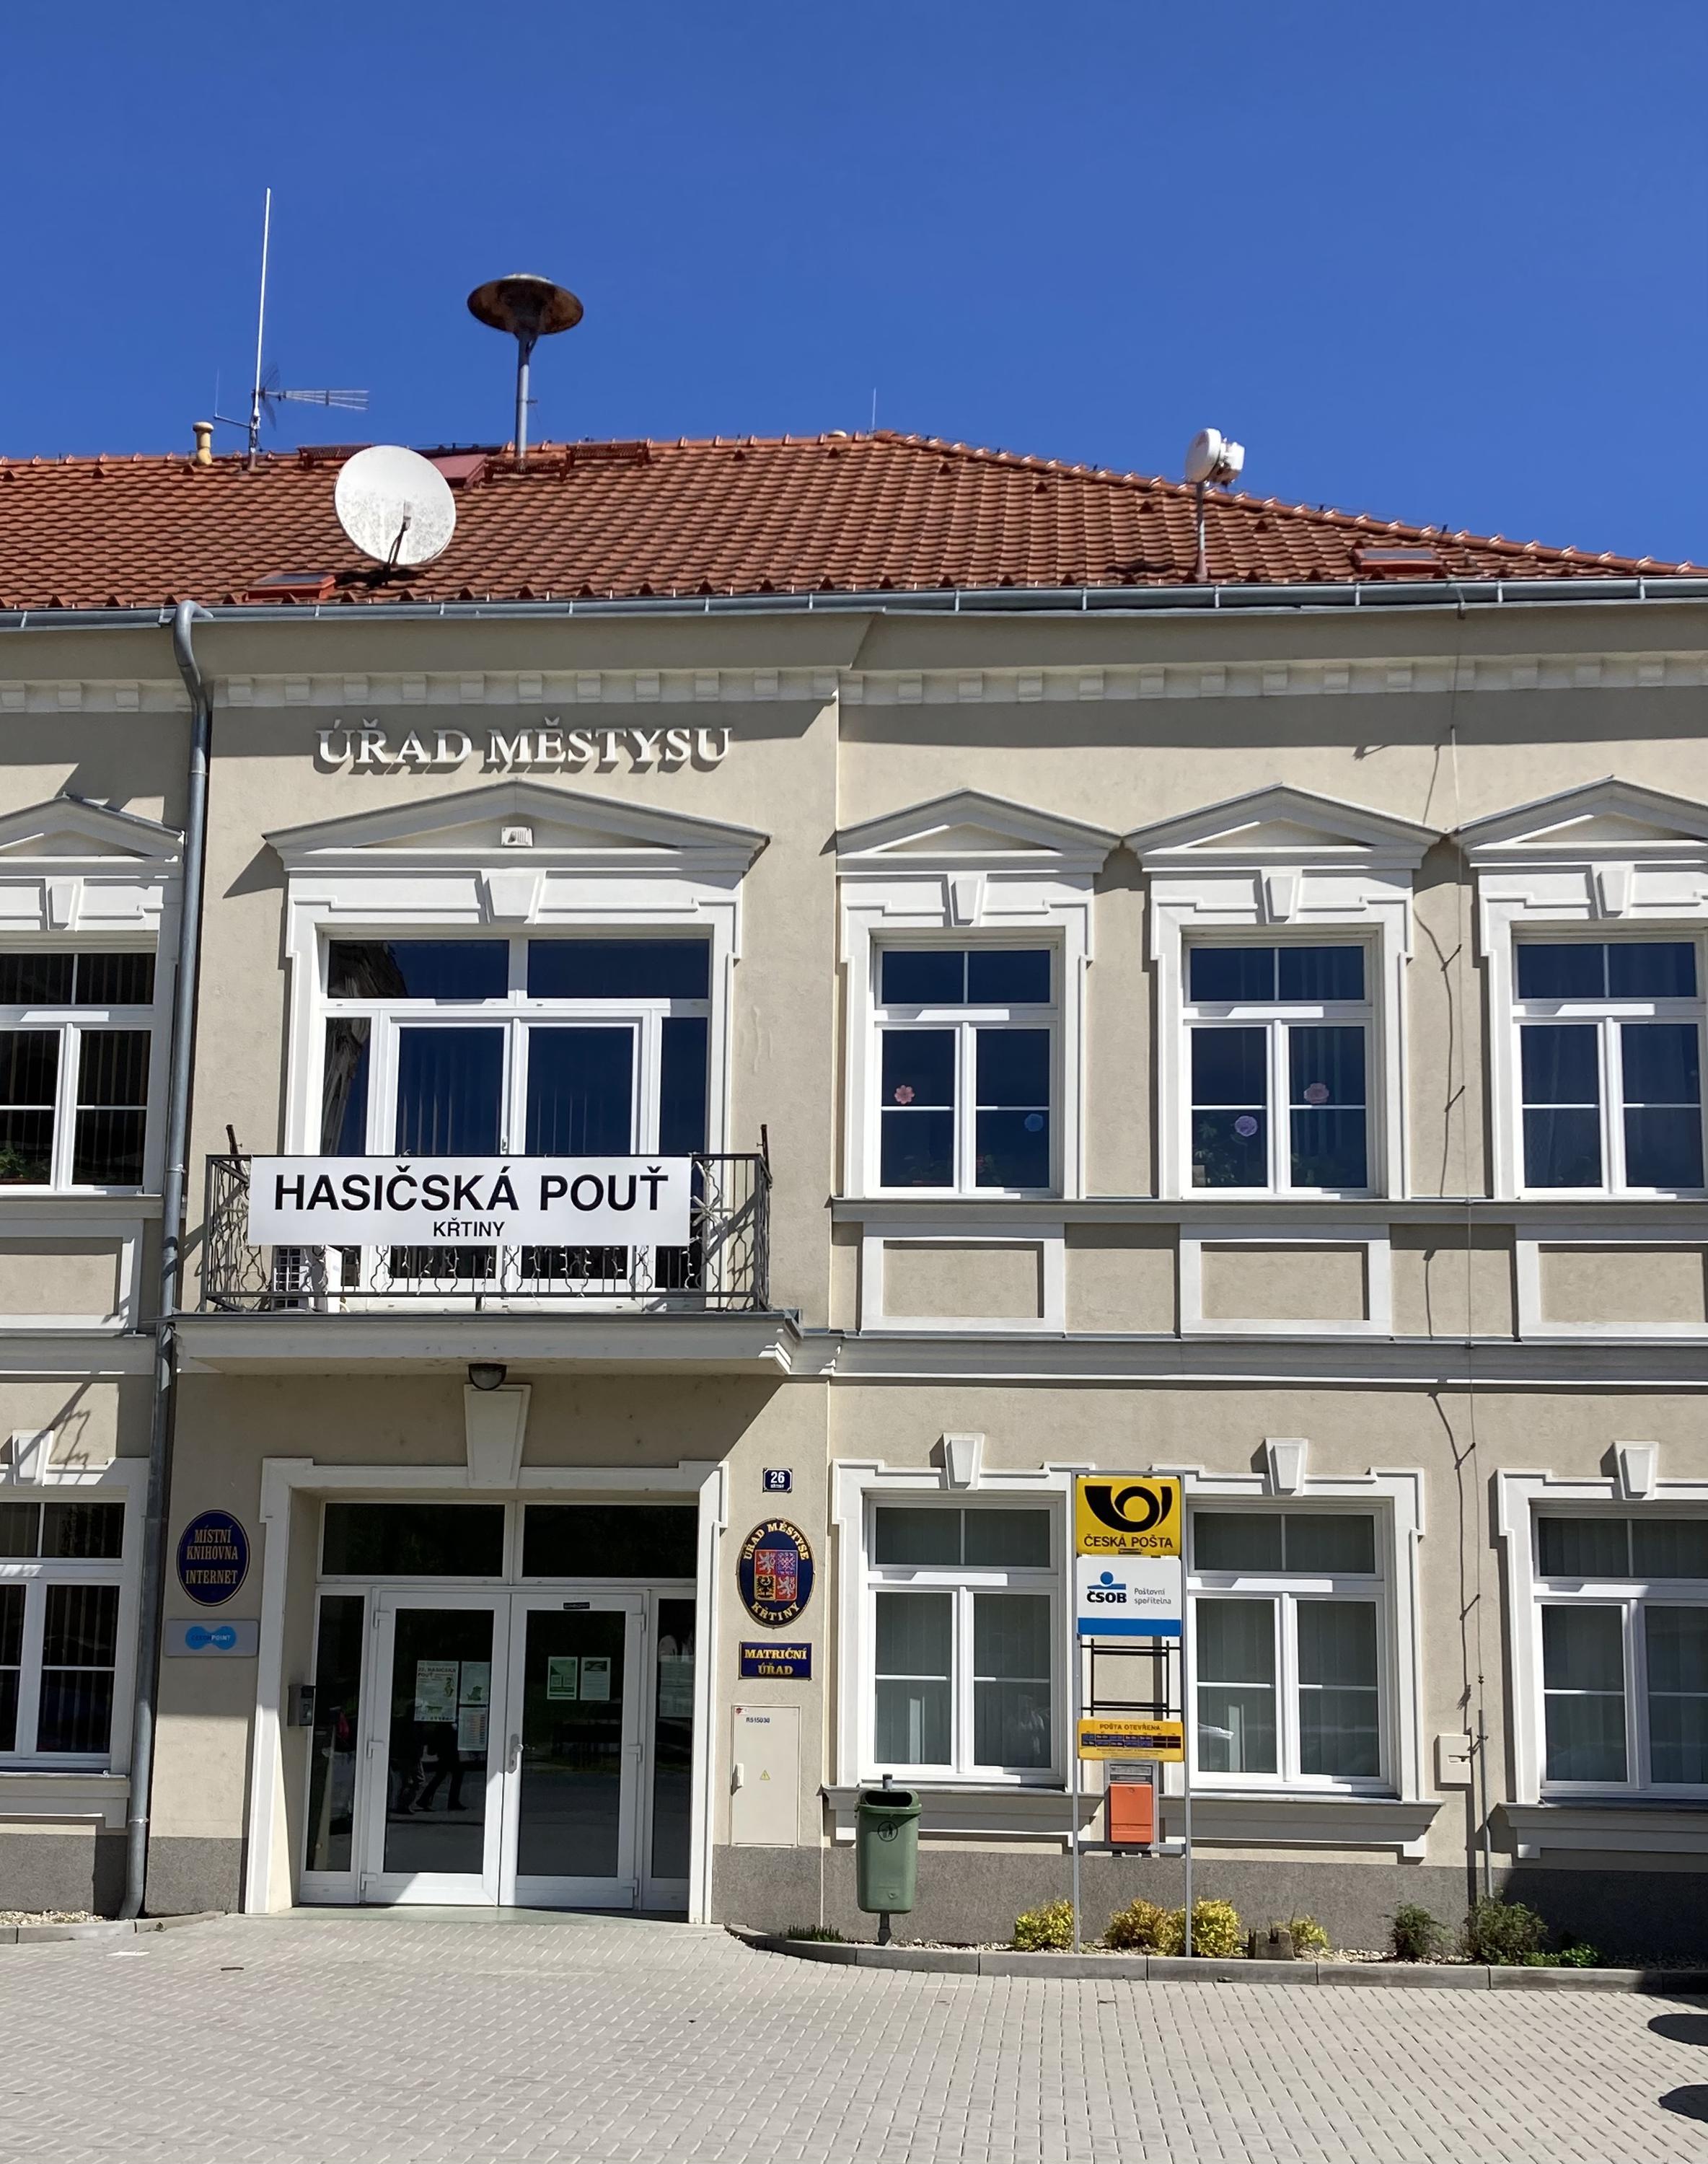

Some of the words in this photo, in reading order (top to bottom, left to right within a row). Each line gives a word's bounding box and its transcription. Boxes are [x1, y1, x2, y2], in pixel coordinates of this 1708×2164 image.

[316, 718, 472, 763] ÚŘAD
[486, 716, 733, 762] MĚSTYSU
[274, 1164, 519, 1211] HASIČSKÁ
[540, 1166, 669, 1211] POUŤ
[433, 1217, 506, 1237] KŘTINY
[770, 1472, 785, 1484] 26
[194, 1525, 232, 1543] MÍSTNÍ
[1084, 1534, 1127, 1547] ČESKÁ
[1131, 1535, 1173, 1548] POŠTA
[187, 1546, 238, 1560] KNIHOVNA
[185, 1570, 237, 1583] INTERNET
[1086, 1591, 1127, 1603] ČSOB
[751, 1601, 799, 1622] KŘTINY
[744, 1647, 806, 1660] MATRIČNÍ
[757, 1661, 793, 1675] ÚŘAD
